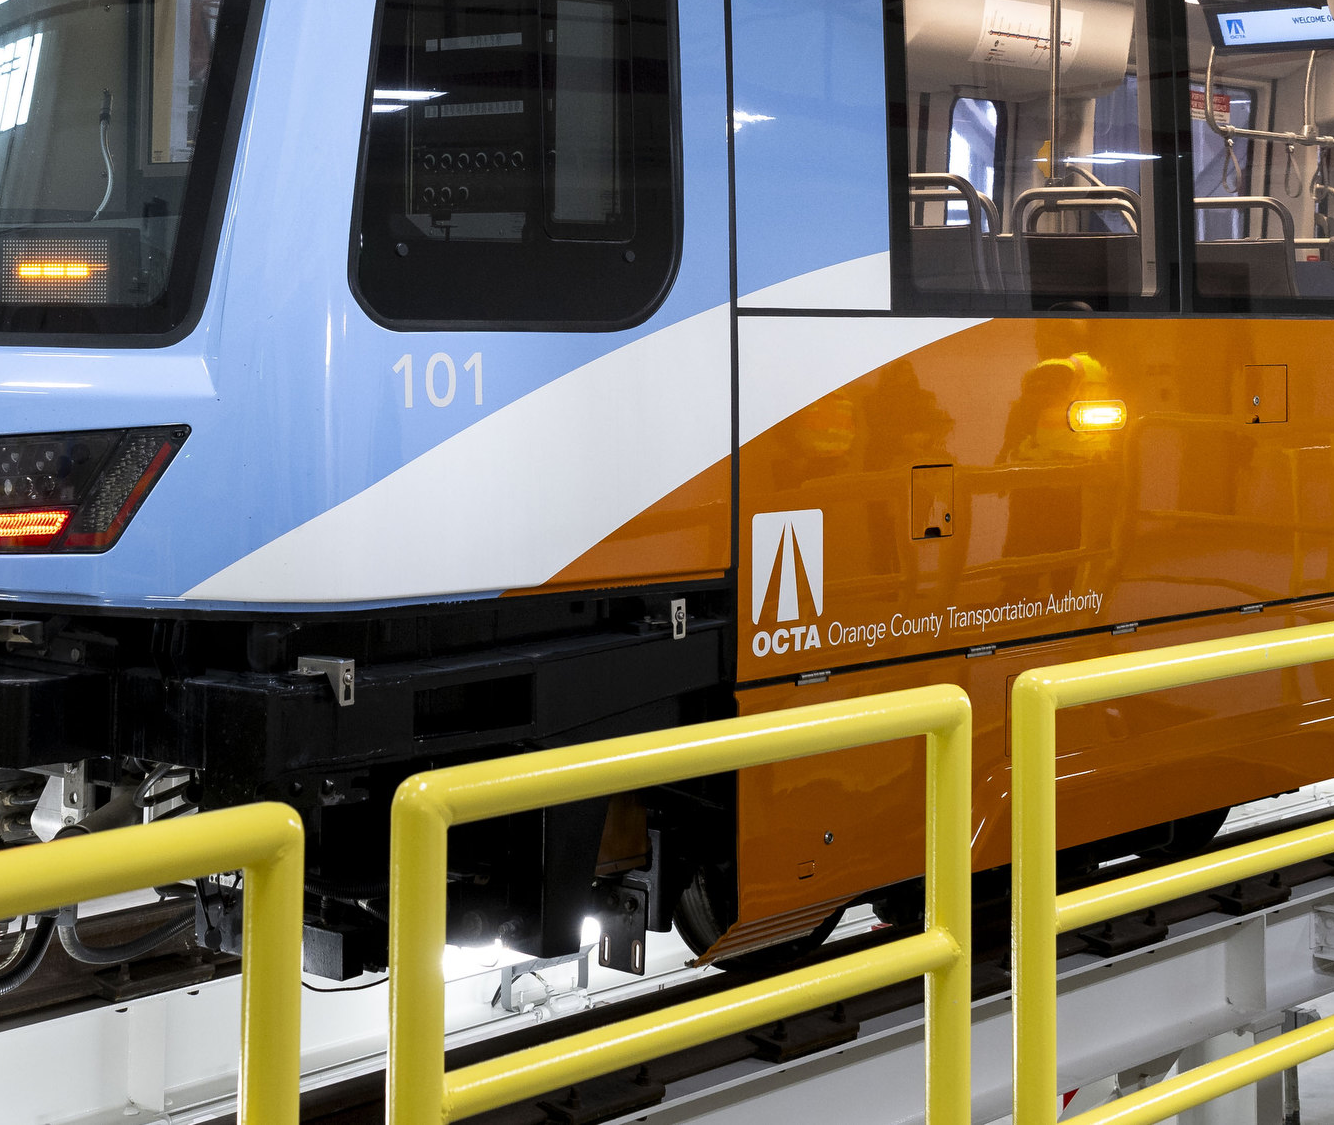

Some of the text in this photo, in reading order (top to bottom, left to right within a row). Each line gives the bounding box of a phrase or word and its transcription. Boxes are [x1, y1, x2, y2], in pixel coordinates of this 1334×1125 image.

[1292, 15, 1326, 24] WELCOME
[391, 351, 484, 410] 101
[752, 589, 1104, 658] OCTA Orange County Transportation Authority
